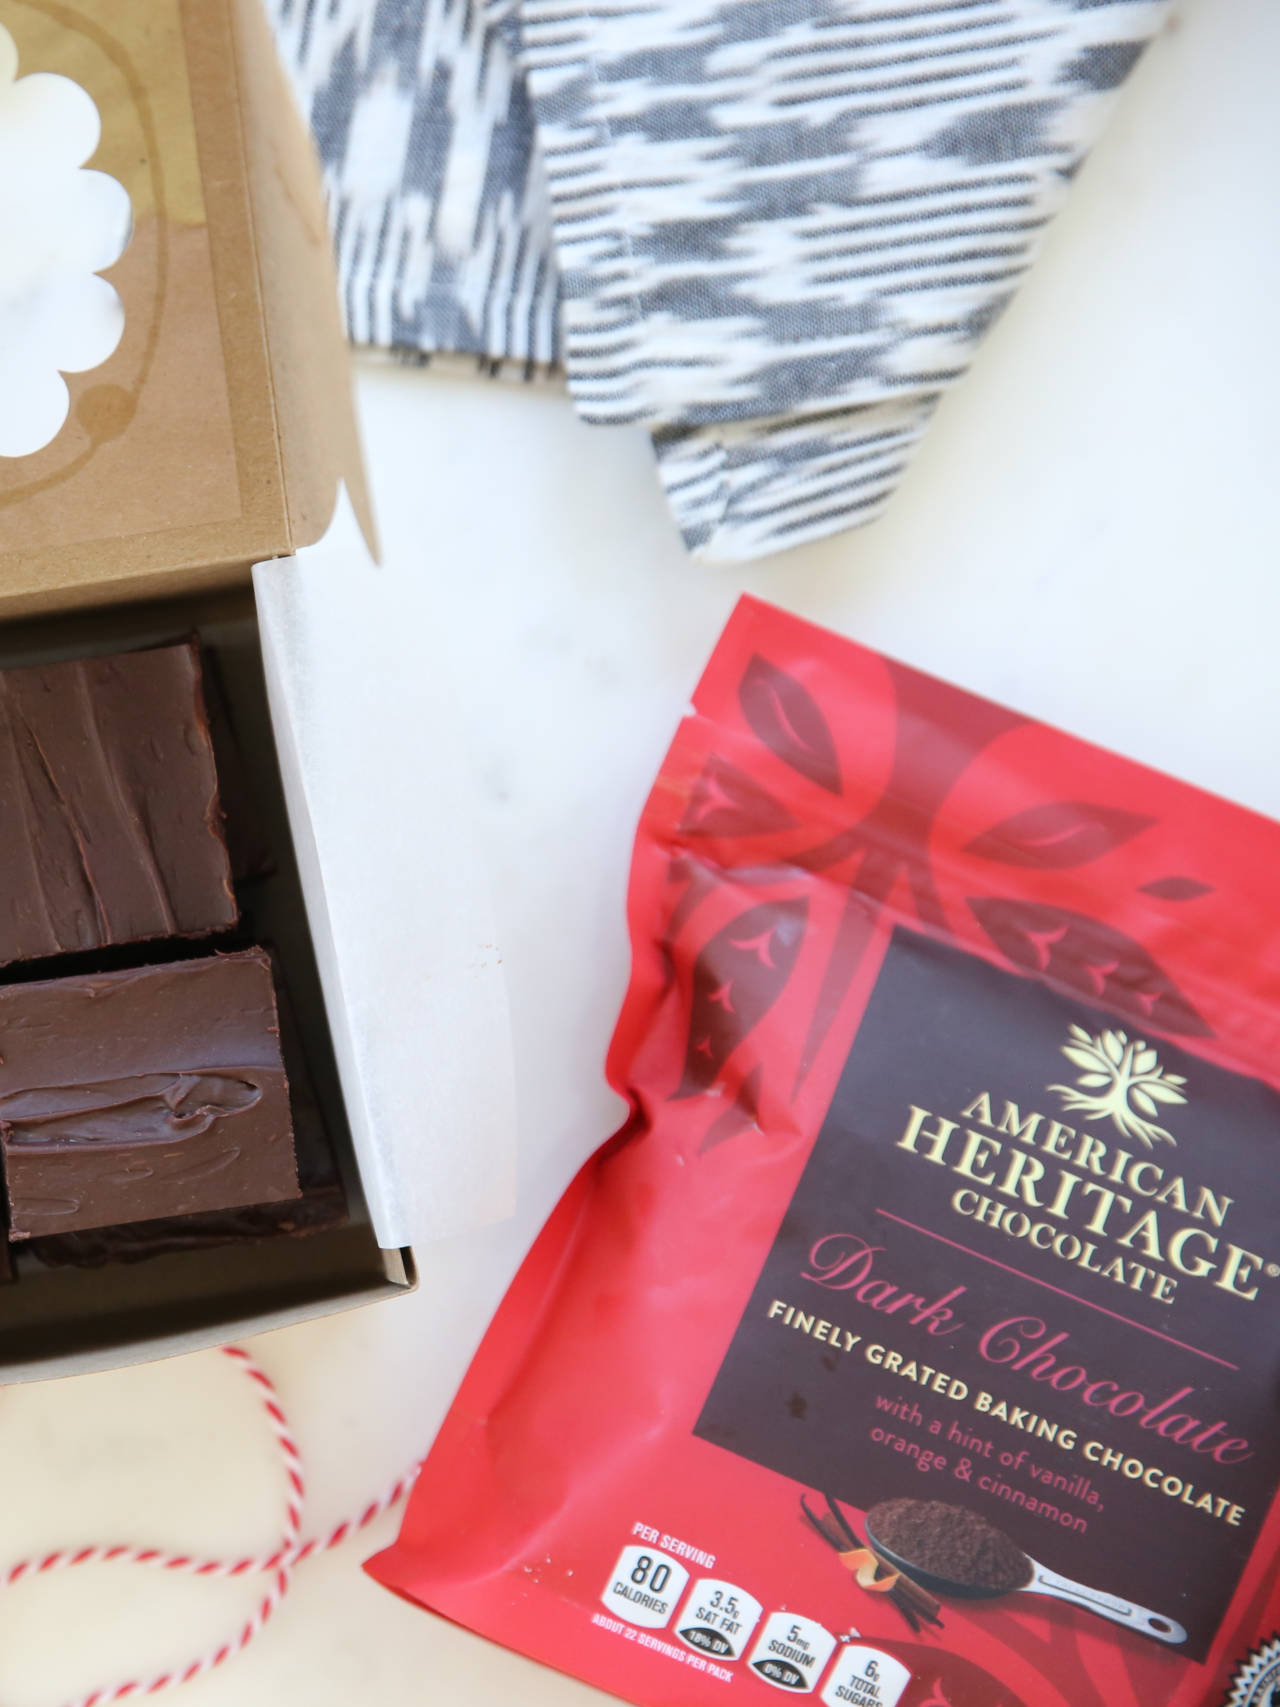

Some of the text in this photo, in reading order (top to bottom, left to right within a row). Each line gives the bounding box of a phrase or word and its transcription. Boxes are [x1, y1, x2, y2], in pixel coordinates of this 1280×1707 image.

[962, 1091, 1234, 1227] AMERICAN
[952, 1188, 1178, 1304] CHOCOLATE
[801, 1233, 1254, 1465] Dark Chocolate
[767, 1300, 1247, 1526] FINELY GRATED BAKING CHOCOLATE
[876, 1393, 1105, 1512] with a hint of vanilla,
[870, 1427, 1089, 1534] orange & cinnamon
[632, 1522, 717, 1569] PER SERVING
[613, 1581, 669, 1615] CALORIES
[631, 1556, 672, 1593] 80
[696, 1607, 743, 1635] SAT FAT
[591, 1613, 734, 1683] ABOUT 22 SERVINGS PER PACK
[712, 1640, 730, 1654] DV
[768, 1640, 816, 1668] SODIUM
[782, 1671, 801, 1686] DV
[850, 1674, 881, 1699] TOTAL
